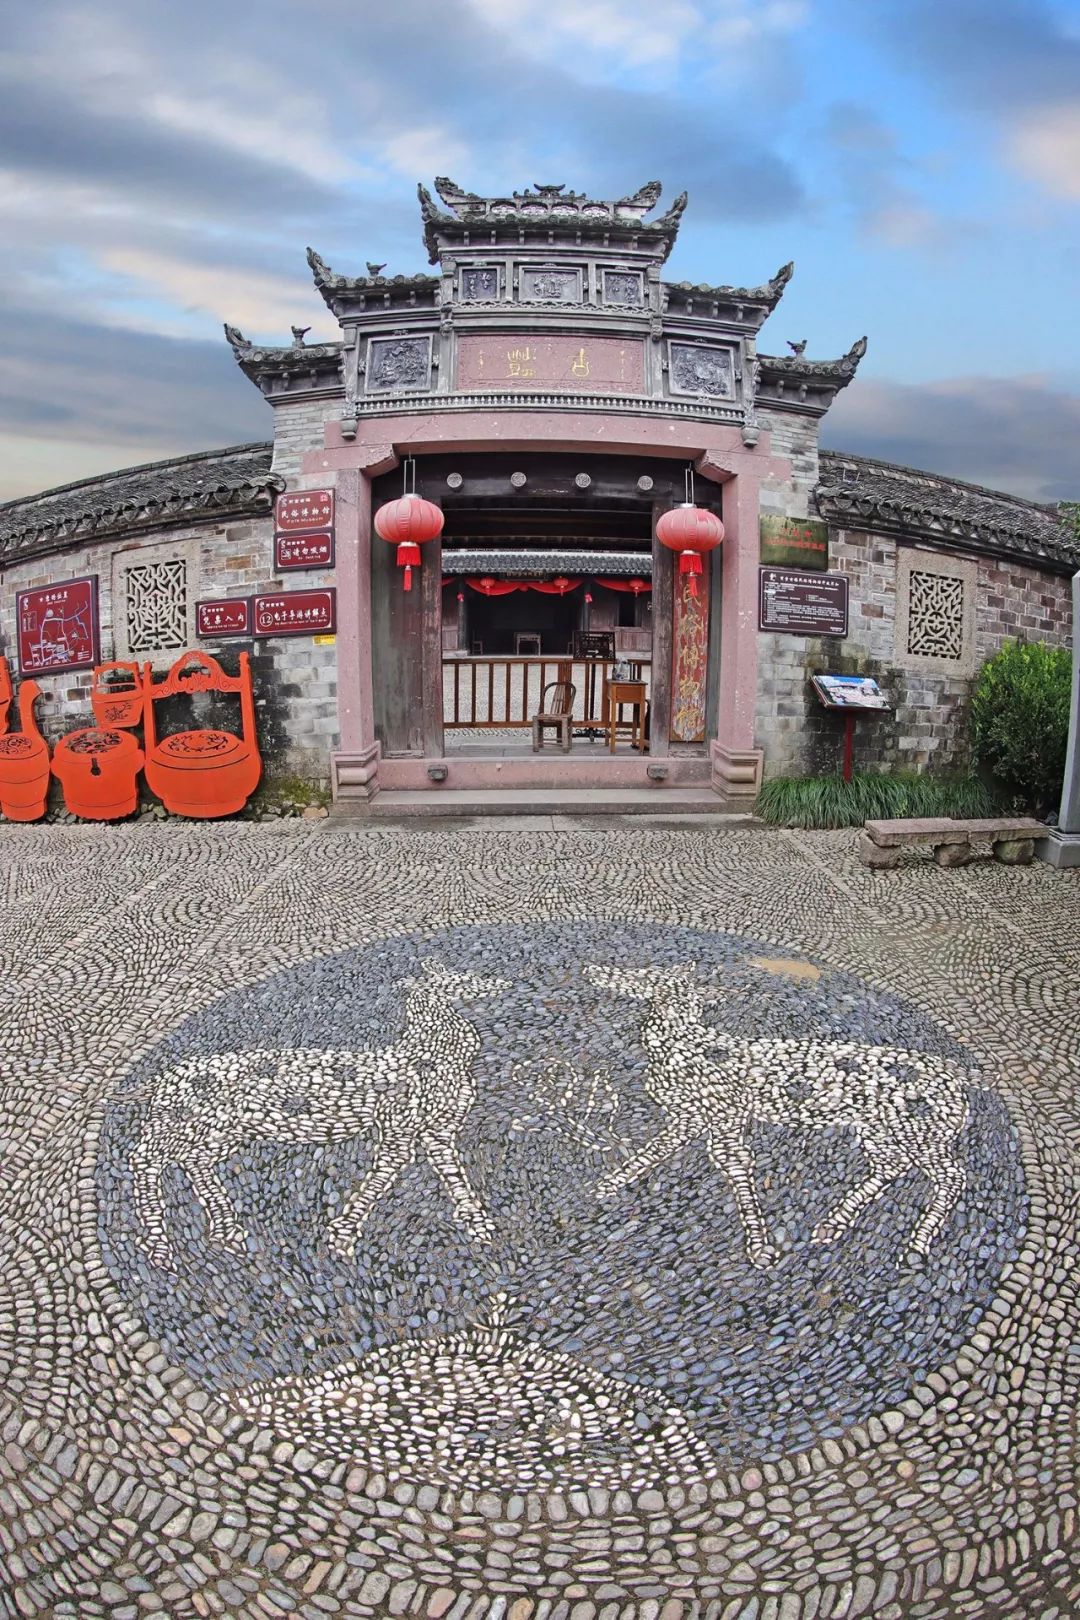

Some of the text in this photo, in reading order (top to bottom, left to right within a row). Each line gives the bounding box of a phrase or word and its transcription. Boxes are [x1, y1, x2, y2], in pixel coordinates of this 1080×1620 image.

[281, 506, 330, 518] 民俗博物馆
[292, 546, 327, 556] 请勿吸烟
[203, 613, 244, 625] 凭票入内
